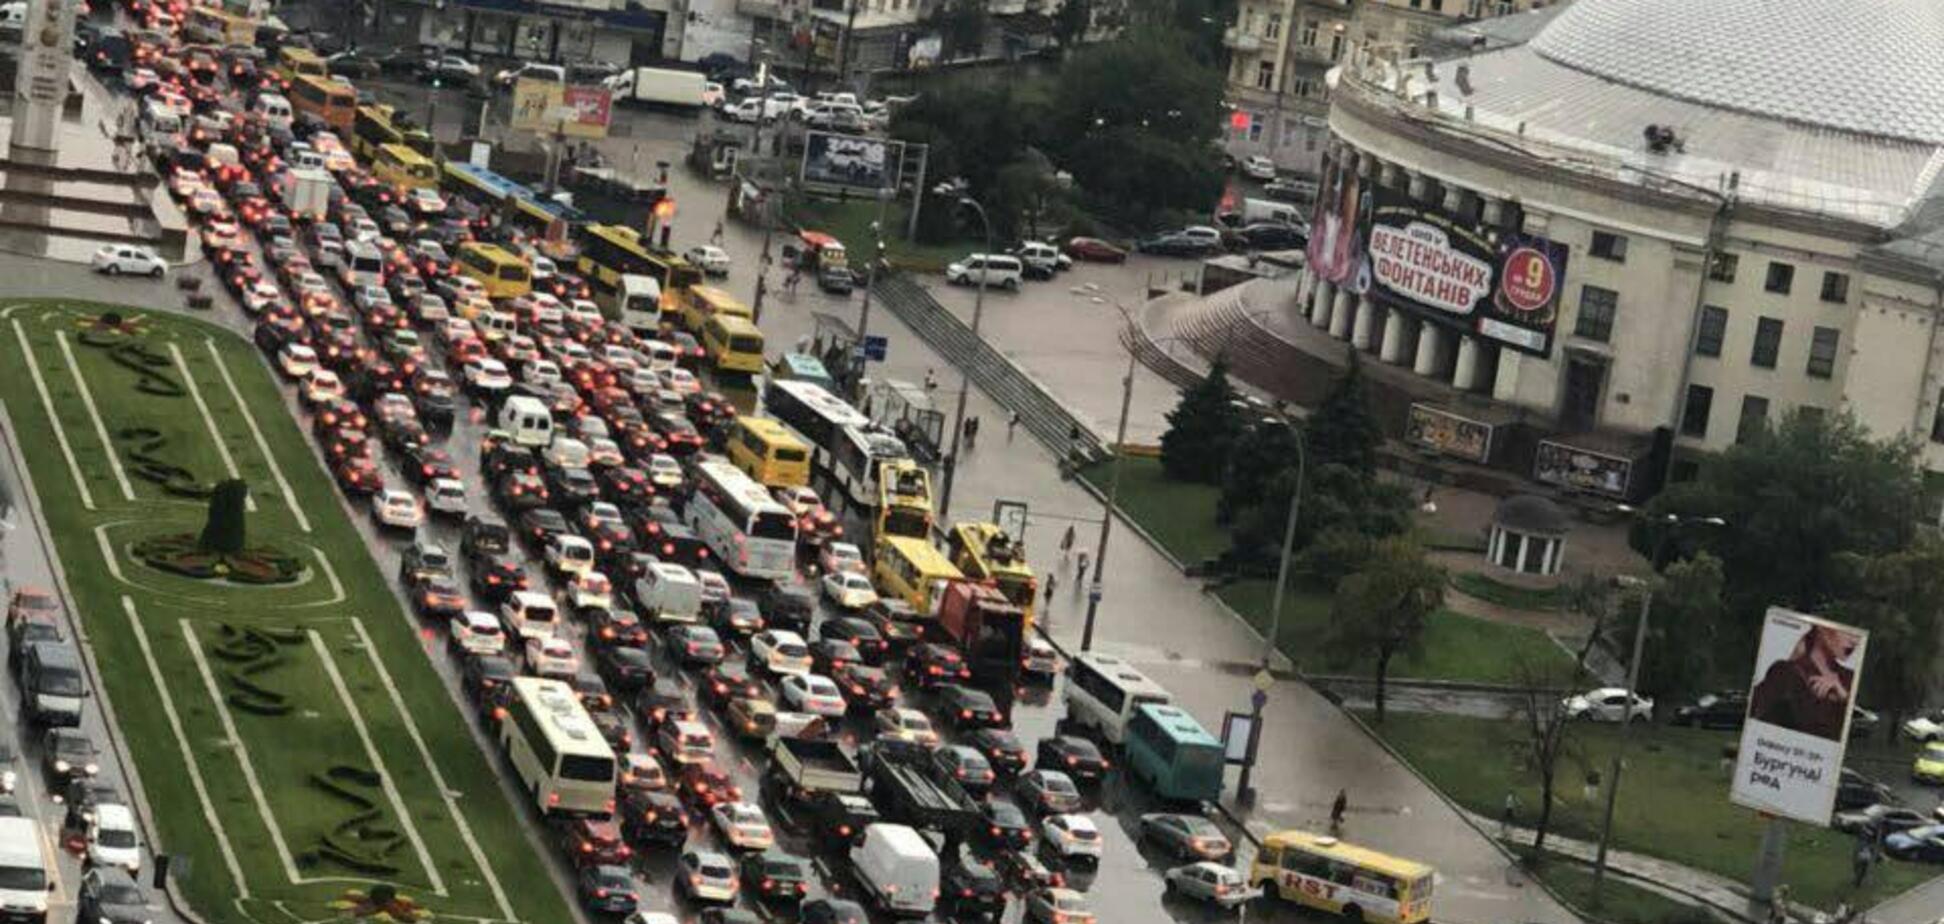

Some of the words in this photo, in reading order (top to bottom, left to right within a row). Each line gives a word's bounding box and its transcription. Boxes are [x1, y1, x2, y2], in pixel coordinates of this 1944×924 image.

[1373, 230, 1488, 291] ВЕЛЕТЕНСЬКИХ
[1526, 257, 1544, 288] 9
[1377, 257, 1472, 307] ФОНТАНІВ
[1284, 873, 1340, 899] RST
